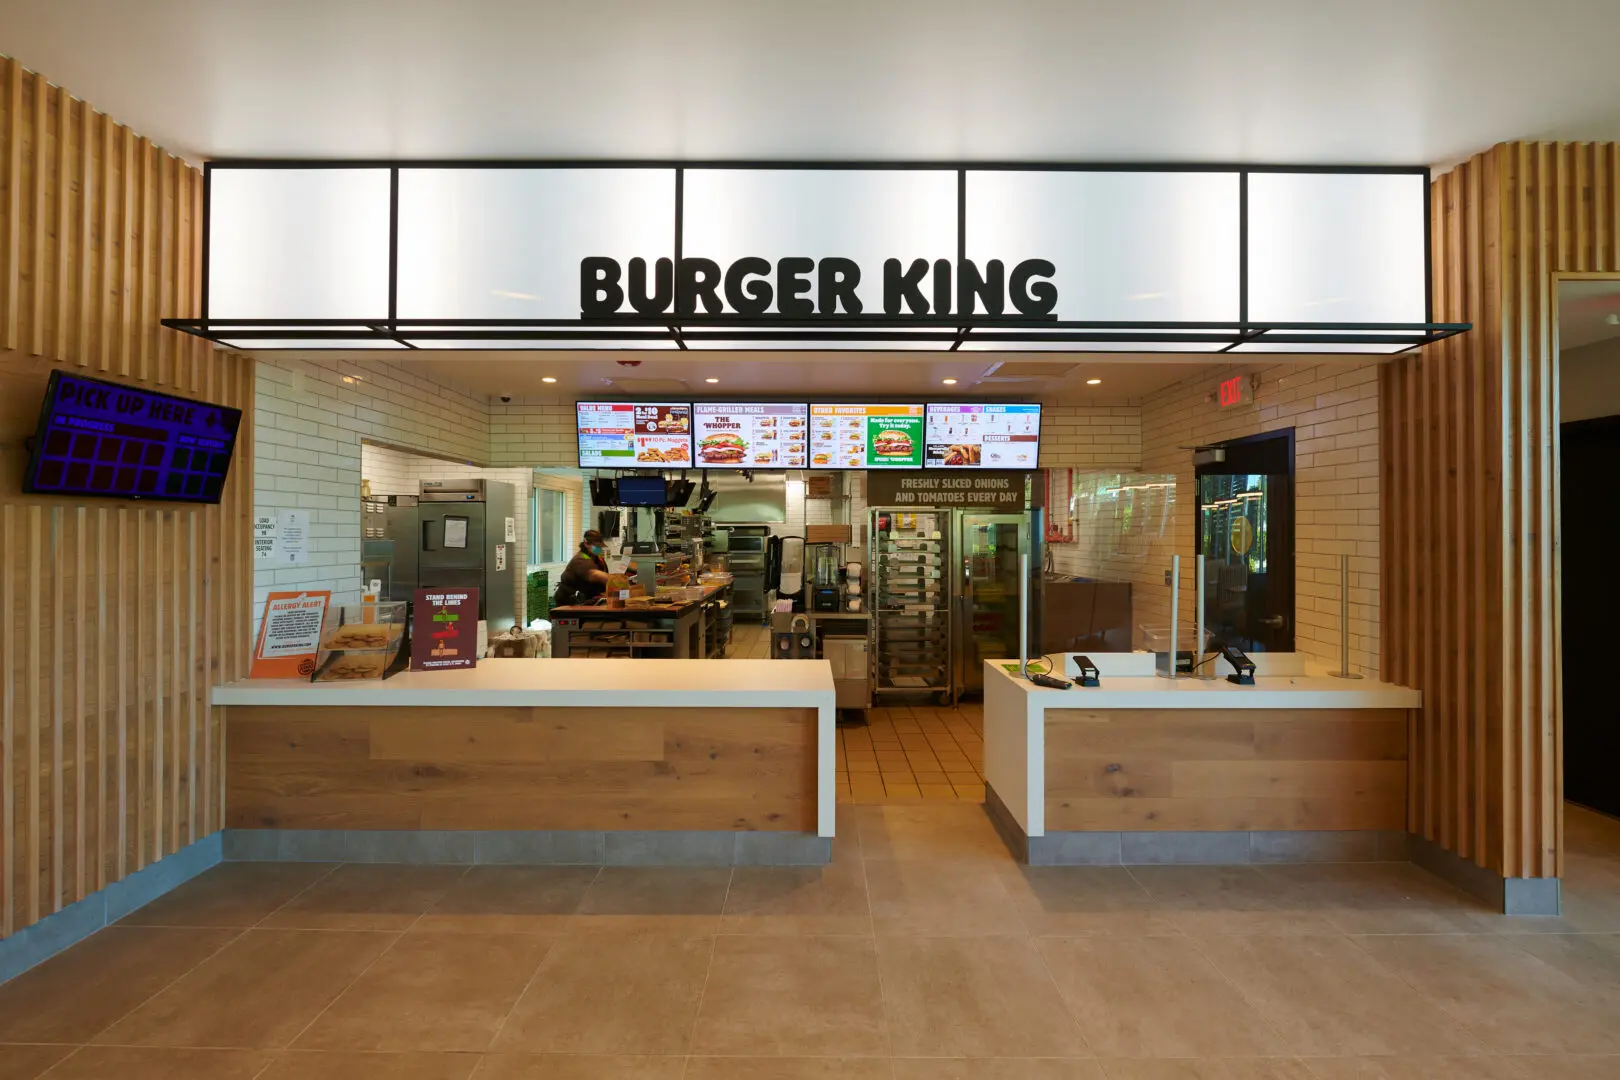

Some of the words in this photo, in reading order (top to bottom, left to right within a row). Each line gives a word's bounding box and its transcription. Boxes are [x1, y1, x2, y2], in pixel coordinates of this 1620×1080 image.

[580, 256, 863, 315] BURGER
[883, 257, 1059, 316] KING
[1221, 376, 1241, 406] EXIT
[59, 381, 113, 411] PICK
[116, 394, 145, 416] UP
[148, 401, 196, 426] HERE
[55, 415, 66, 426] IN
[68, 417, 115, 433] PROGRESS
[901, 478, 940, 489] FRESHLY
[942, 478, 972, 489] SLICED
[974, 478, 1009, 489] ONIONS
[895, 492, 915, 503] AND
[917, 492, 965, 503] TOMATOES
[967, 492, 997, 503] EVERY
[999, 492, 1018, 503] DAY
[272, 602, 301, 611] ALLERGY
[302, 601, 322, 609] ALERT
